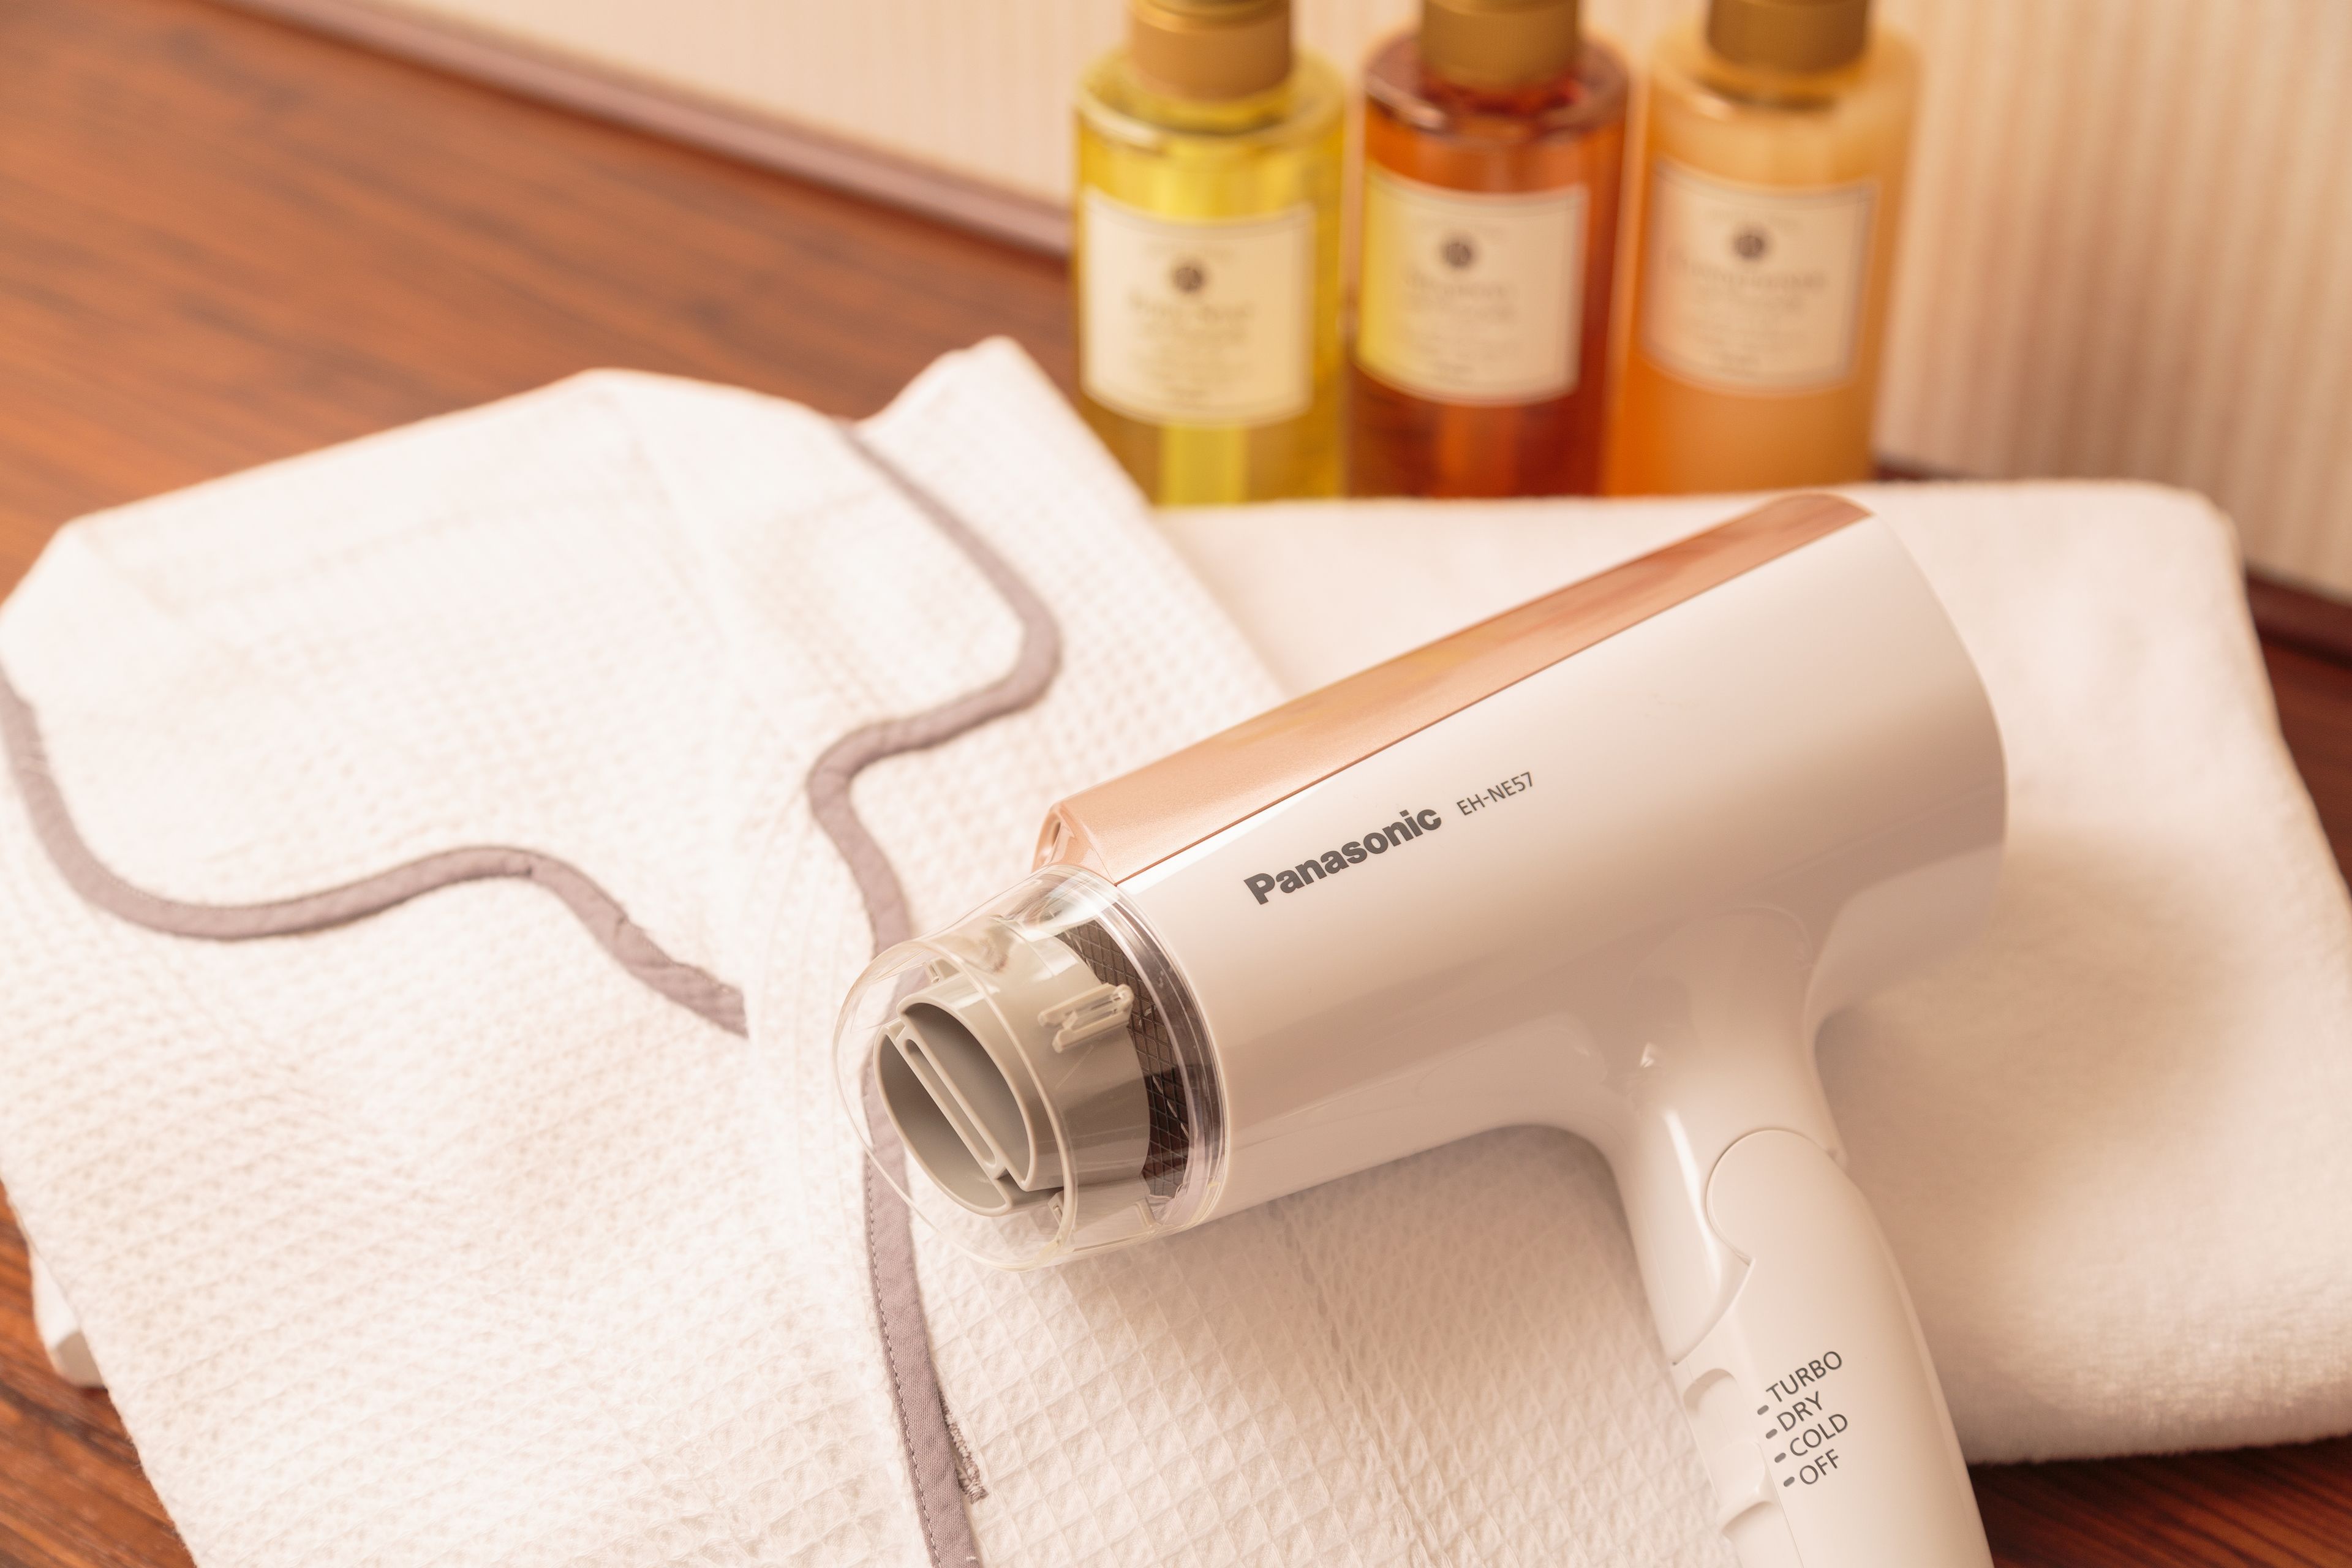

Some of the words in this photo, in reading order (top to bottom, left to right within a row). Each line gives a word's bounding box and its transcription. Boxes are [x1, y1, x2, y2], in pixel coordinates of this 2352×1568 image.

[1243, 808, 1442, 905] Panasonic
[1457, 771, 1534, 816] EH-NE57
[1765, 1351, 1842, 1403] TURBO
[1777, 1390, 1823, 1432] DRY
[1790, 1414, 1848, 1457] COLD
[1800, 1449, 1839, 1485] OFF
